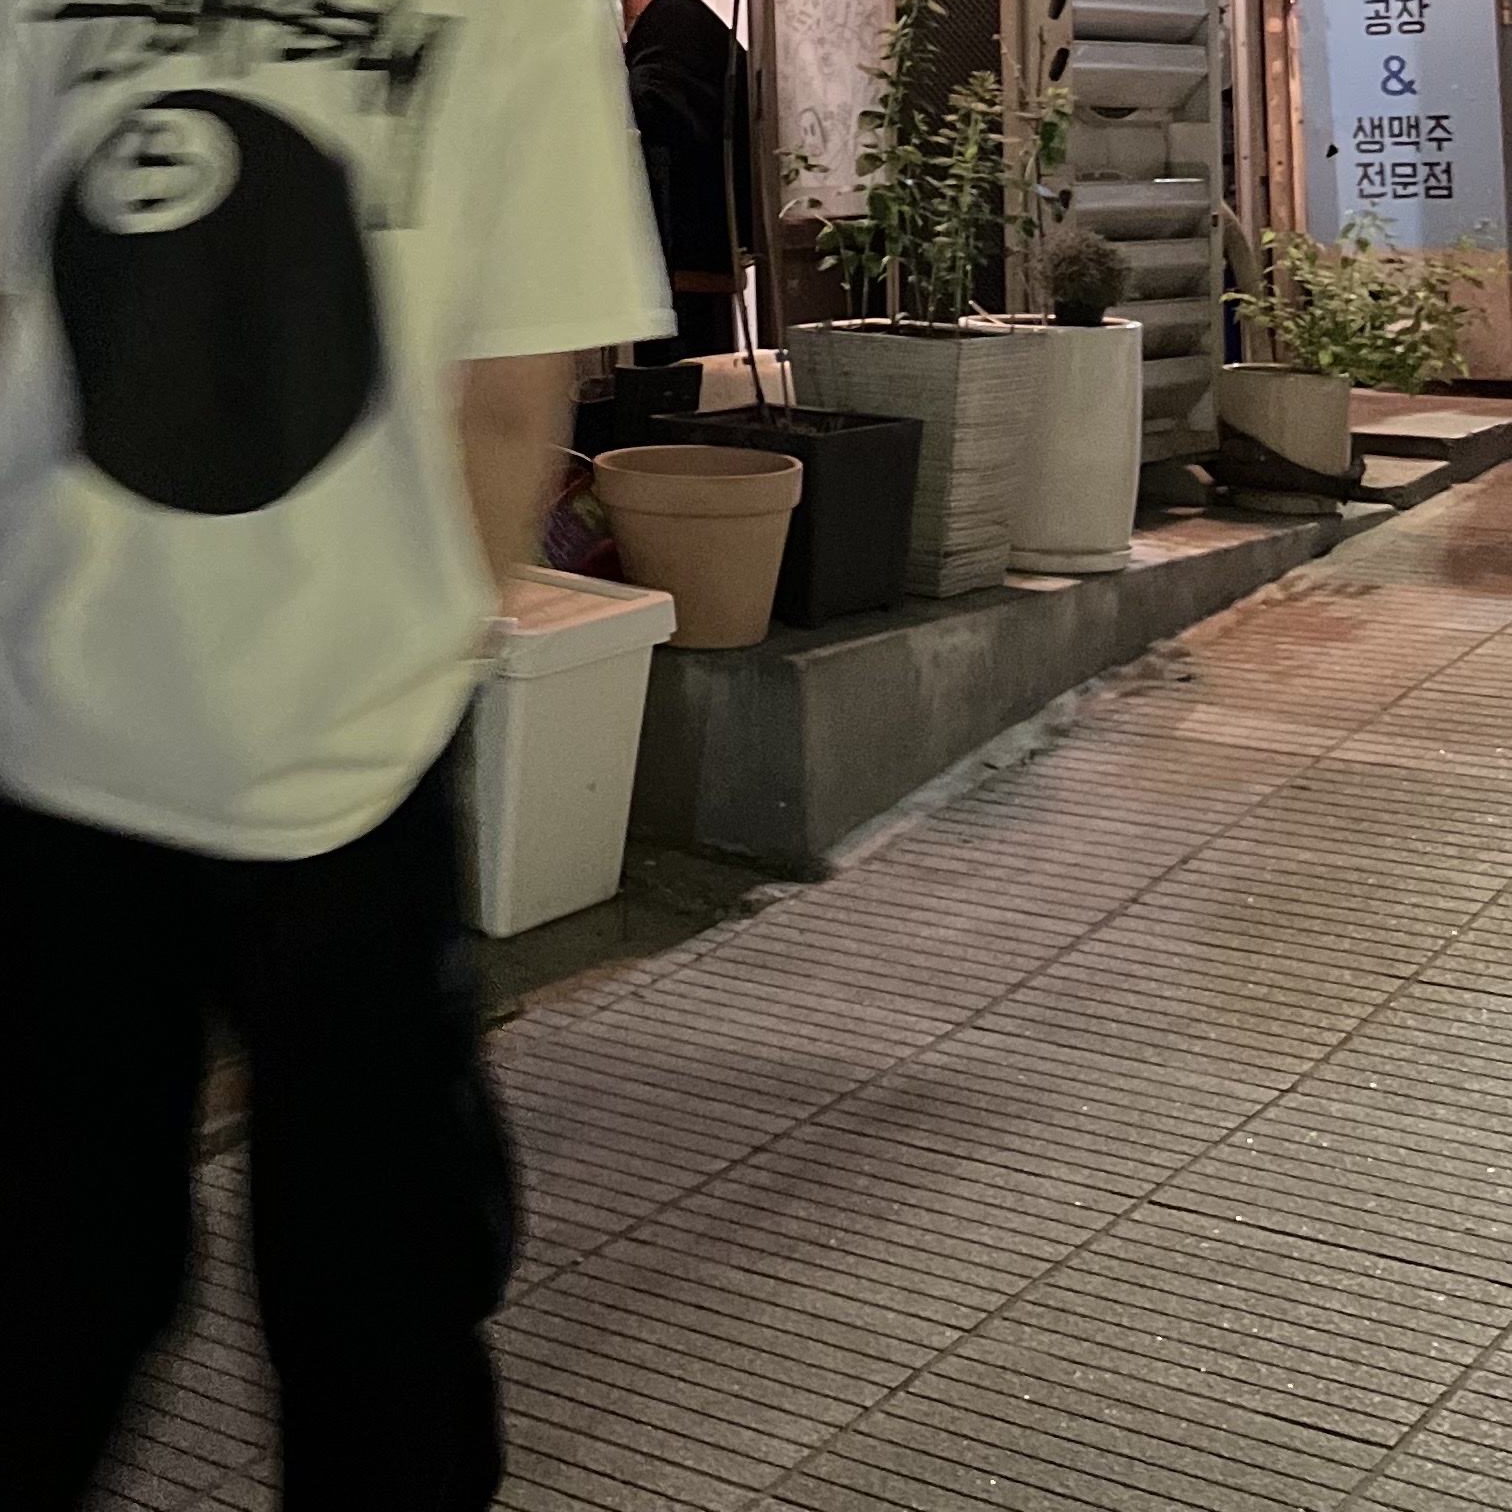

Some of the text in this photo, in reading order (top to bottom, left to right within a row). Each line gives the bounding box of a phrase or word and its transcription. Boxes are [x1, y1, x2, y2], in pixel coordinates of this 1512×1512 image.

[1380, 54, 1418, 96] &
[1352, 114, 1454, 154] 생맥주
[1355, 160, 1454, 200] 전문점
